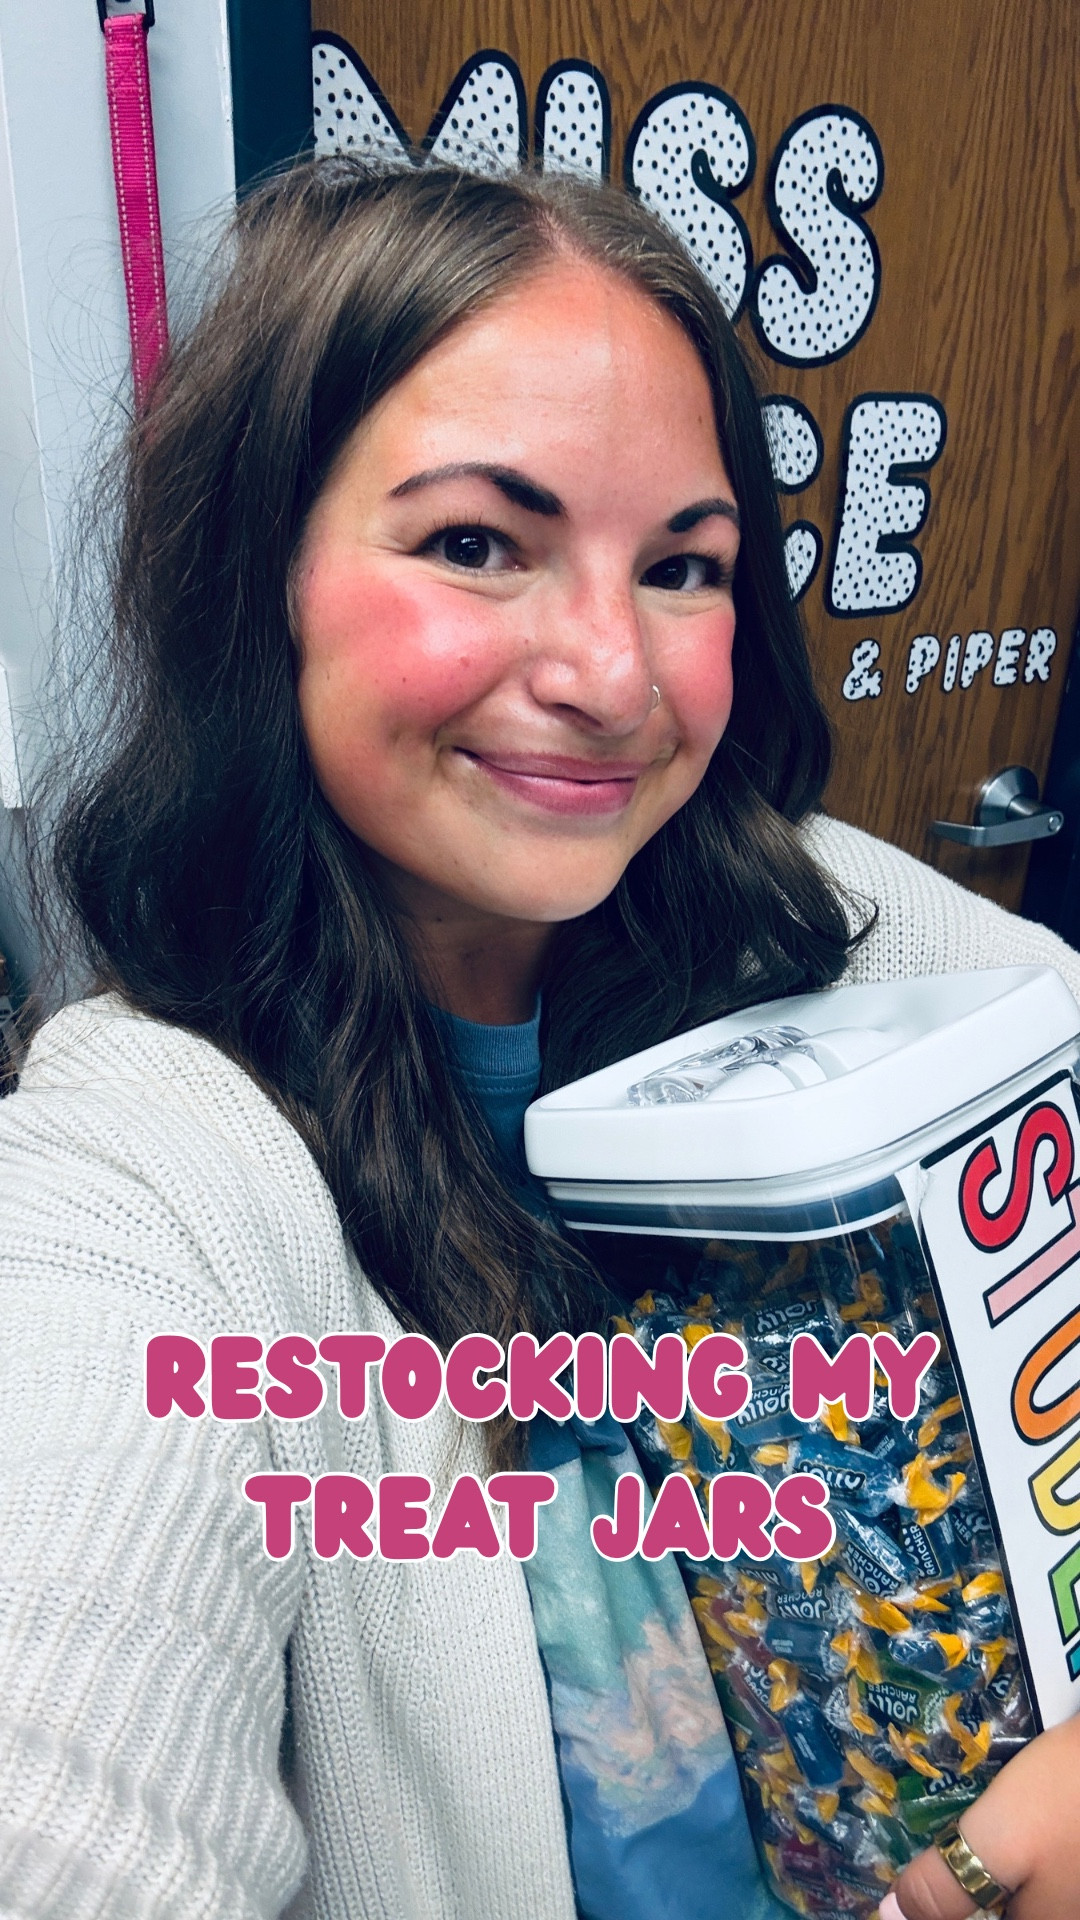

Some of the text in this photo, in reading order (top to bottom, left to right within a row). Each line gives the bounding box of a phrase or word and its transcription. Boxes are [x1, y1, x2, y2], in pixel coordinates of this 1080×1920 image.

[842, 627, 1058, 701] & PIPER
[757, 1301, 817, 1333] JOLLY
[848, 1545, 899, 1591] RANCHER
[909, 1524, 936, 1576] RANCHER
[778, 1599, 828, 1619] JOLLY
[867, 1692, 919, 1725] JOLLY
